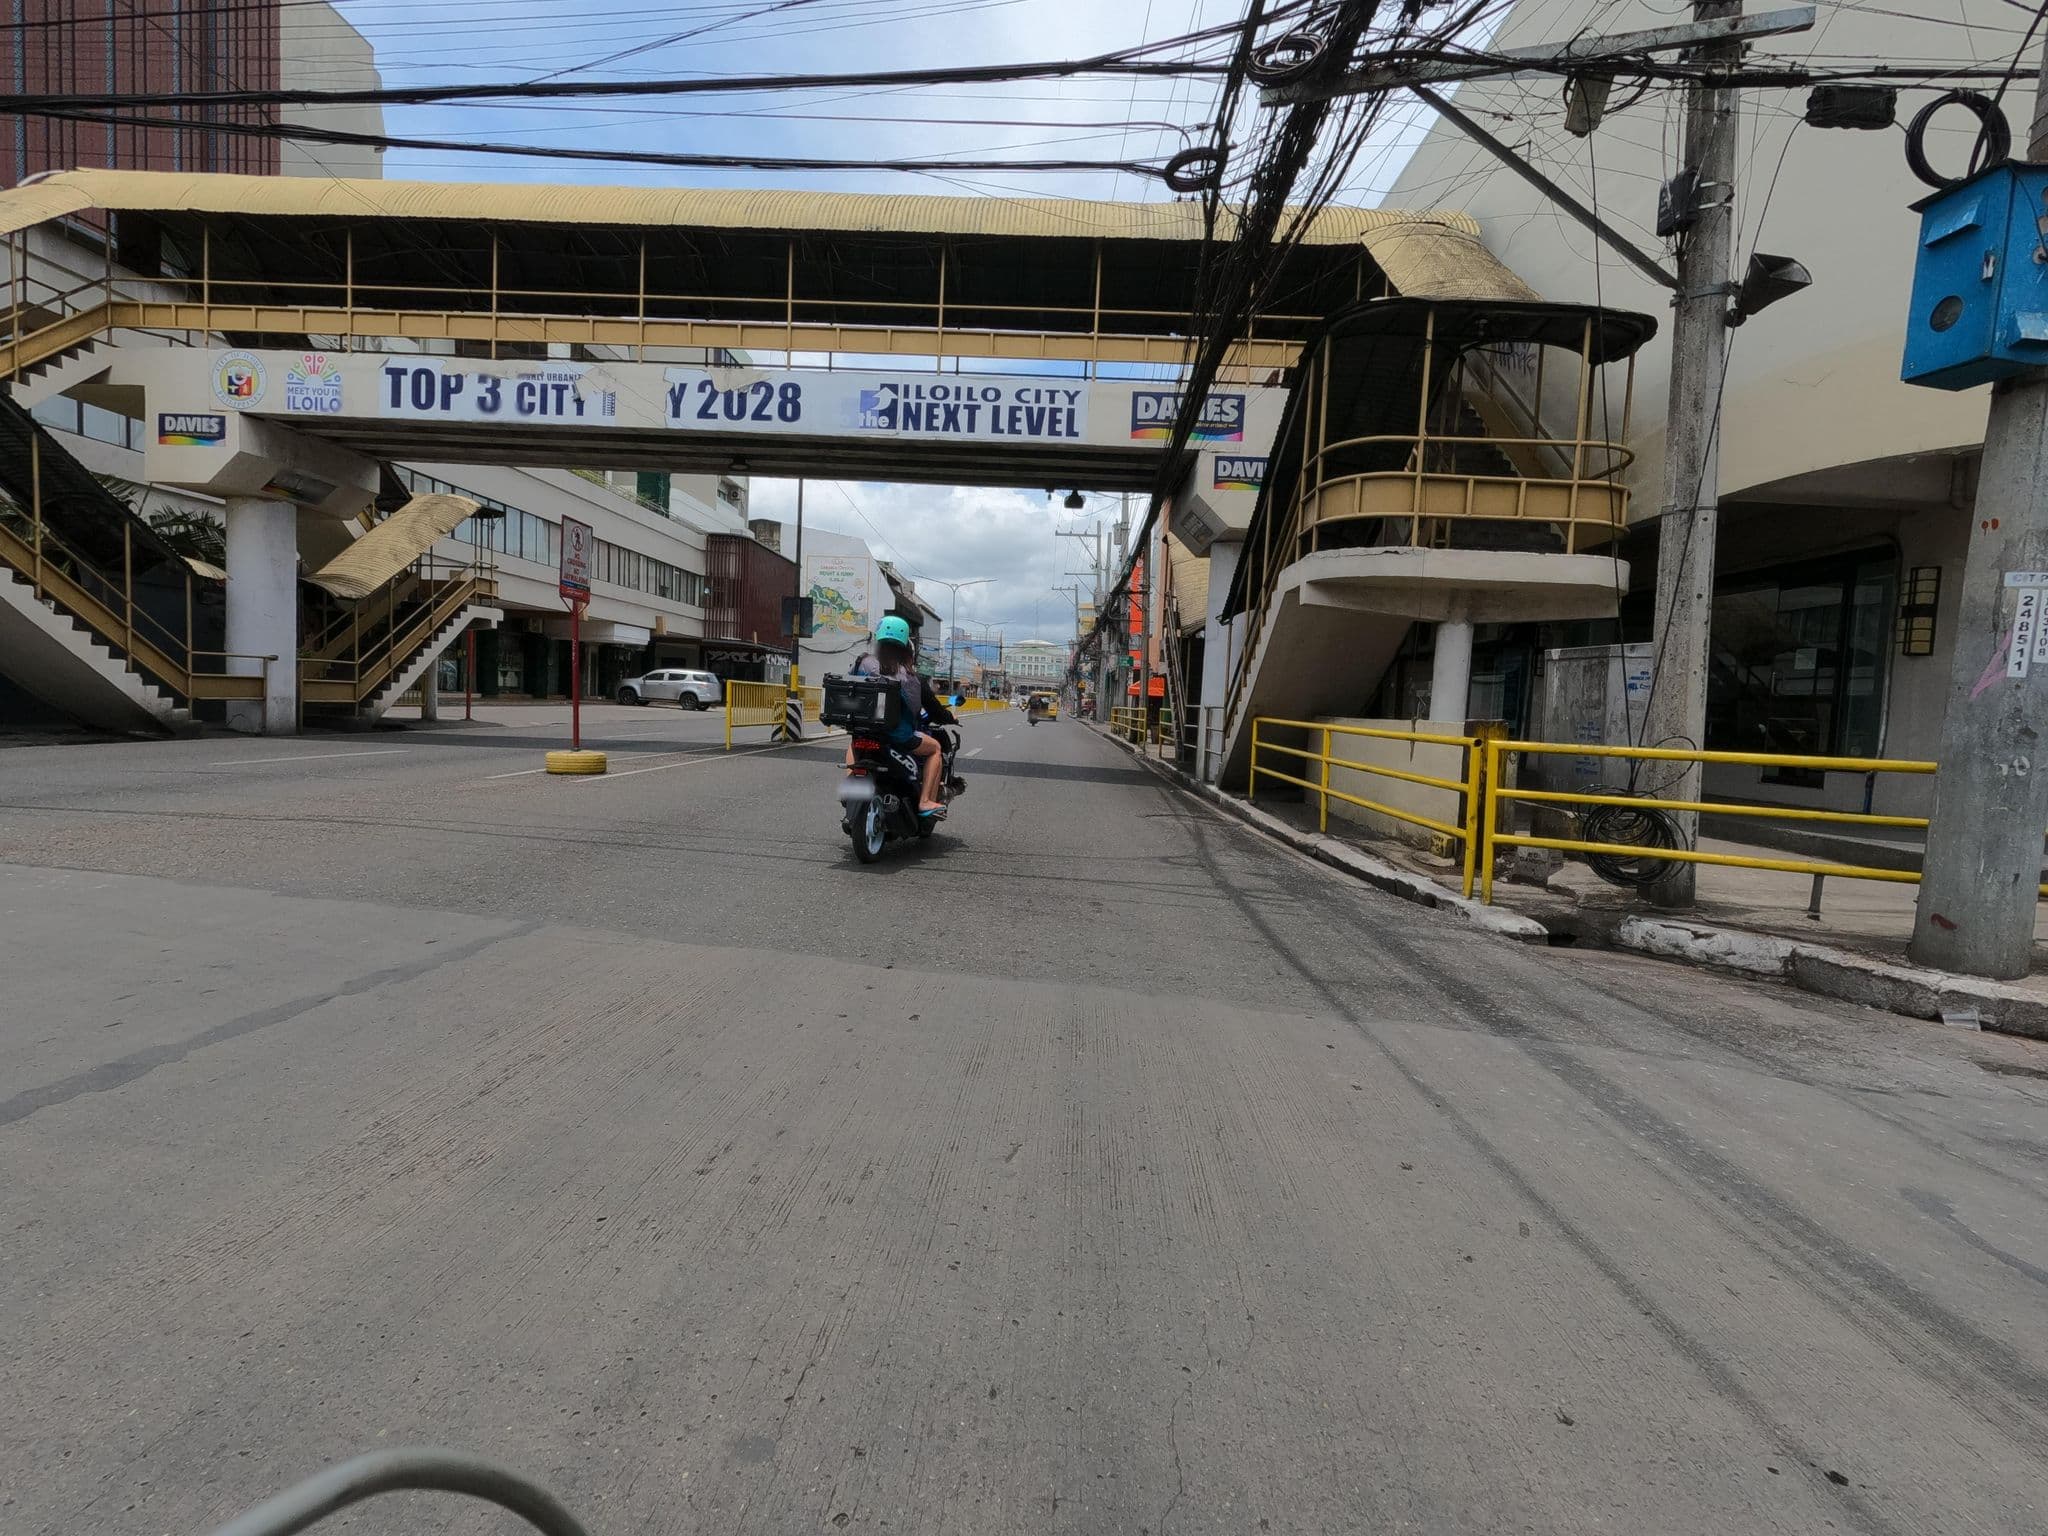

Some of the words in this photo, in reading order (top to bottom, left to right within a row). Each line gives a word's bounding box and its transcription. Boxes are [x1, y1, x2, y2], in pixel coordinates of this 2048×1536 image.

[287, 387, 309, 396] MEET
[312, 388, 330, 396] YOU
[385, 367, 464, 410] TOP
[477, 373, 501, 413] 3
[516, 381, 585, 416] CITY
[696, 379, 801, 422] 2028
[903, 384, 1001, 402] ILOILO
[1015, 388, 1082, 405] CITY
[287, 396, 341, 412] ILOILO
[1136, 396, 1240, 422] DAES
[164, 416, 219, 433] DAVIES
[859, 410, 889, 428] the
[902, 401, 981, 433] NEXT
[991, 404, 1080, 437] LEVEL
[1217, 460, 1267, 478] DAVI
[2014, 595, 2034, 671] 248511
